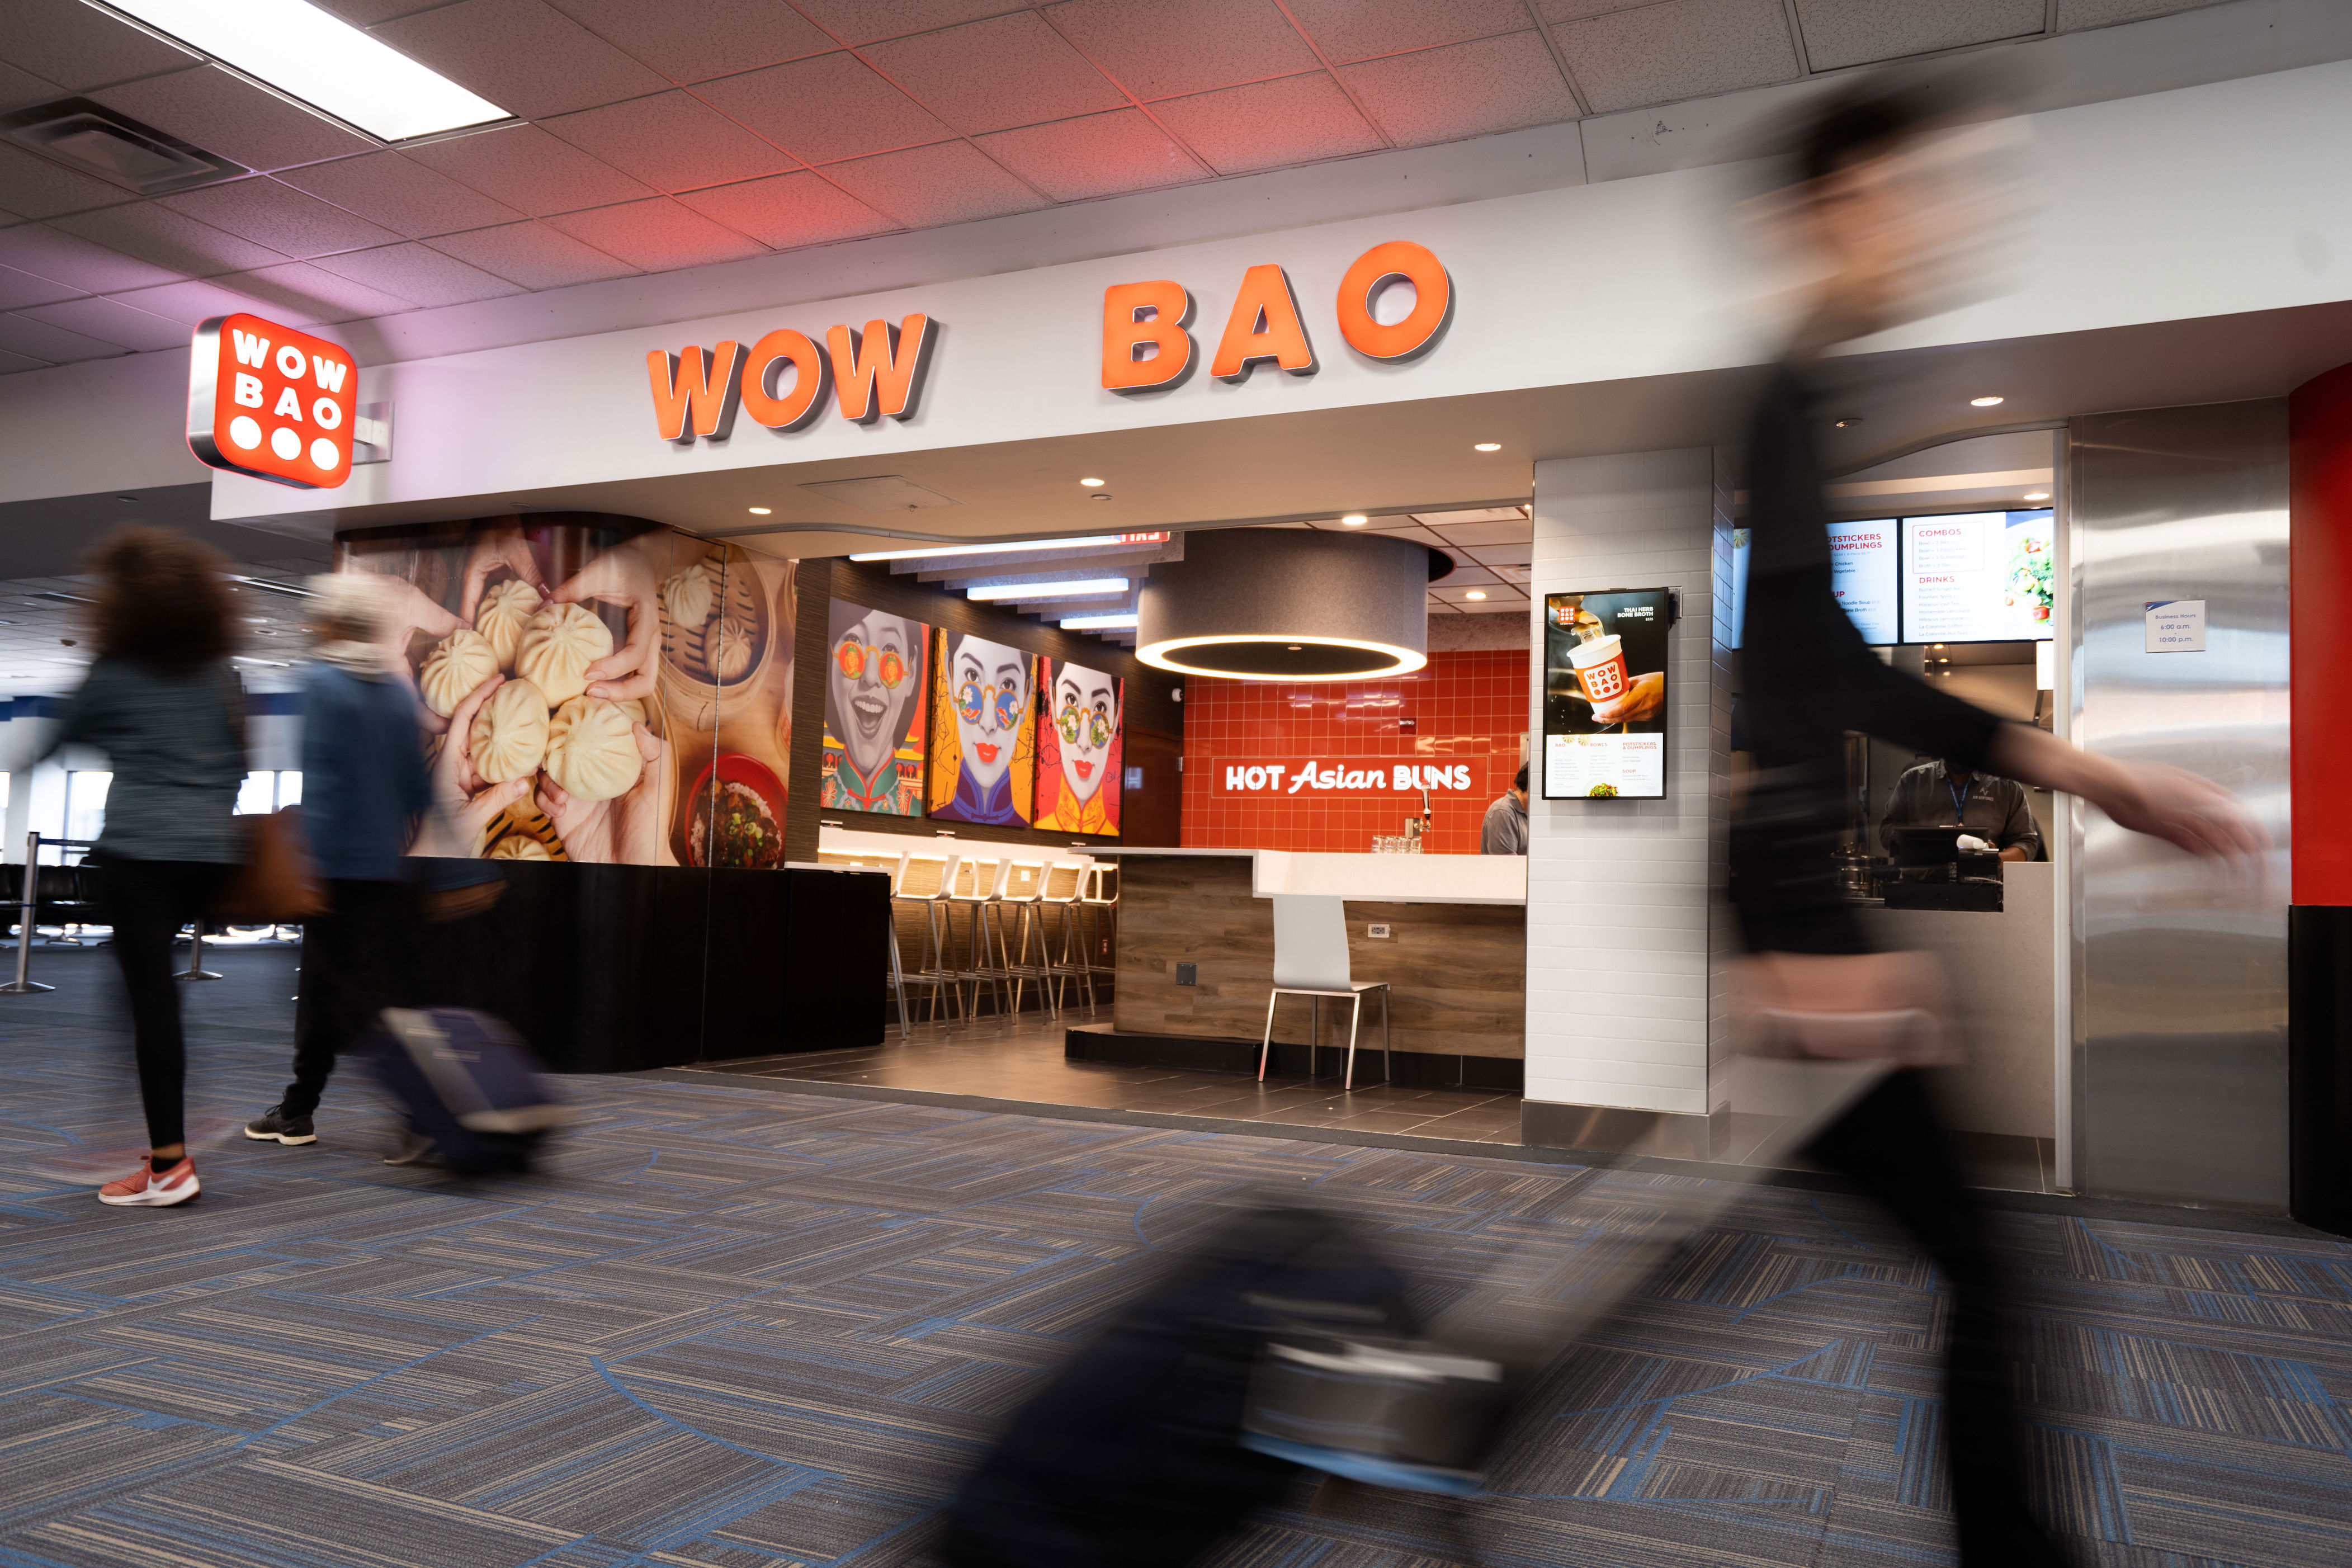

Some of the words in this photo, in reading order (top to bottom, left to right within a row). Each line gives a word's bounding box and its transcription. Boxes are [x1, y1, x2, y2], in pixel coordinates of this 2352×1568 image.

[647, 312, 937, 443] WOW
[1102, 240, 1452, 393] BAO
[232, 329, 347, 394] WOW
[234, 371, 342, 430] BAO
[1827, 533, 1882, 542] OTSTICKERS
[1919, 528, 1962, 537] COMBOS
[1586, 664, 1616, 680] WOW
[1590, 674, 1618, 688] BAO
[1226, 766, 1285, 791] HOT
[1288, 761, 1387, 794] Asian
[1393, 765, 1471, 791] BUNS
